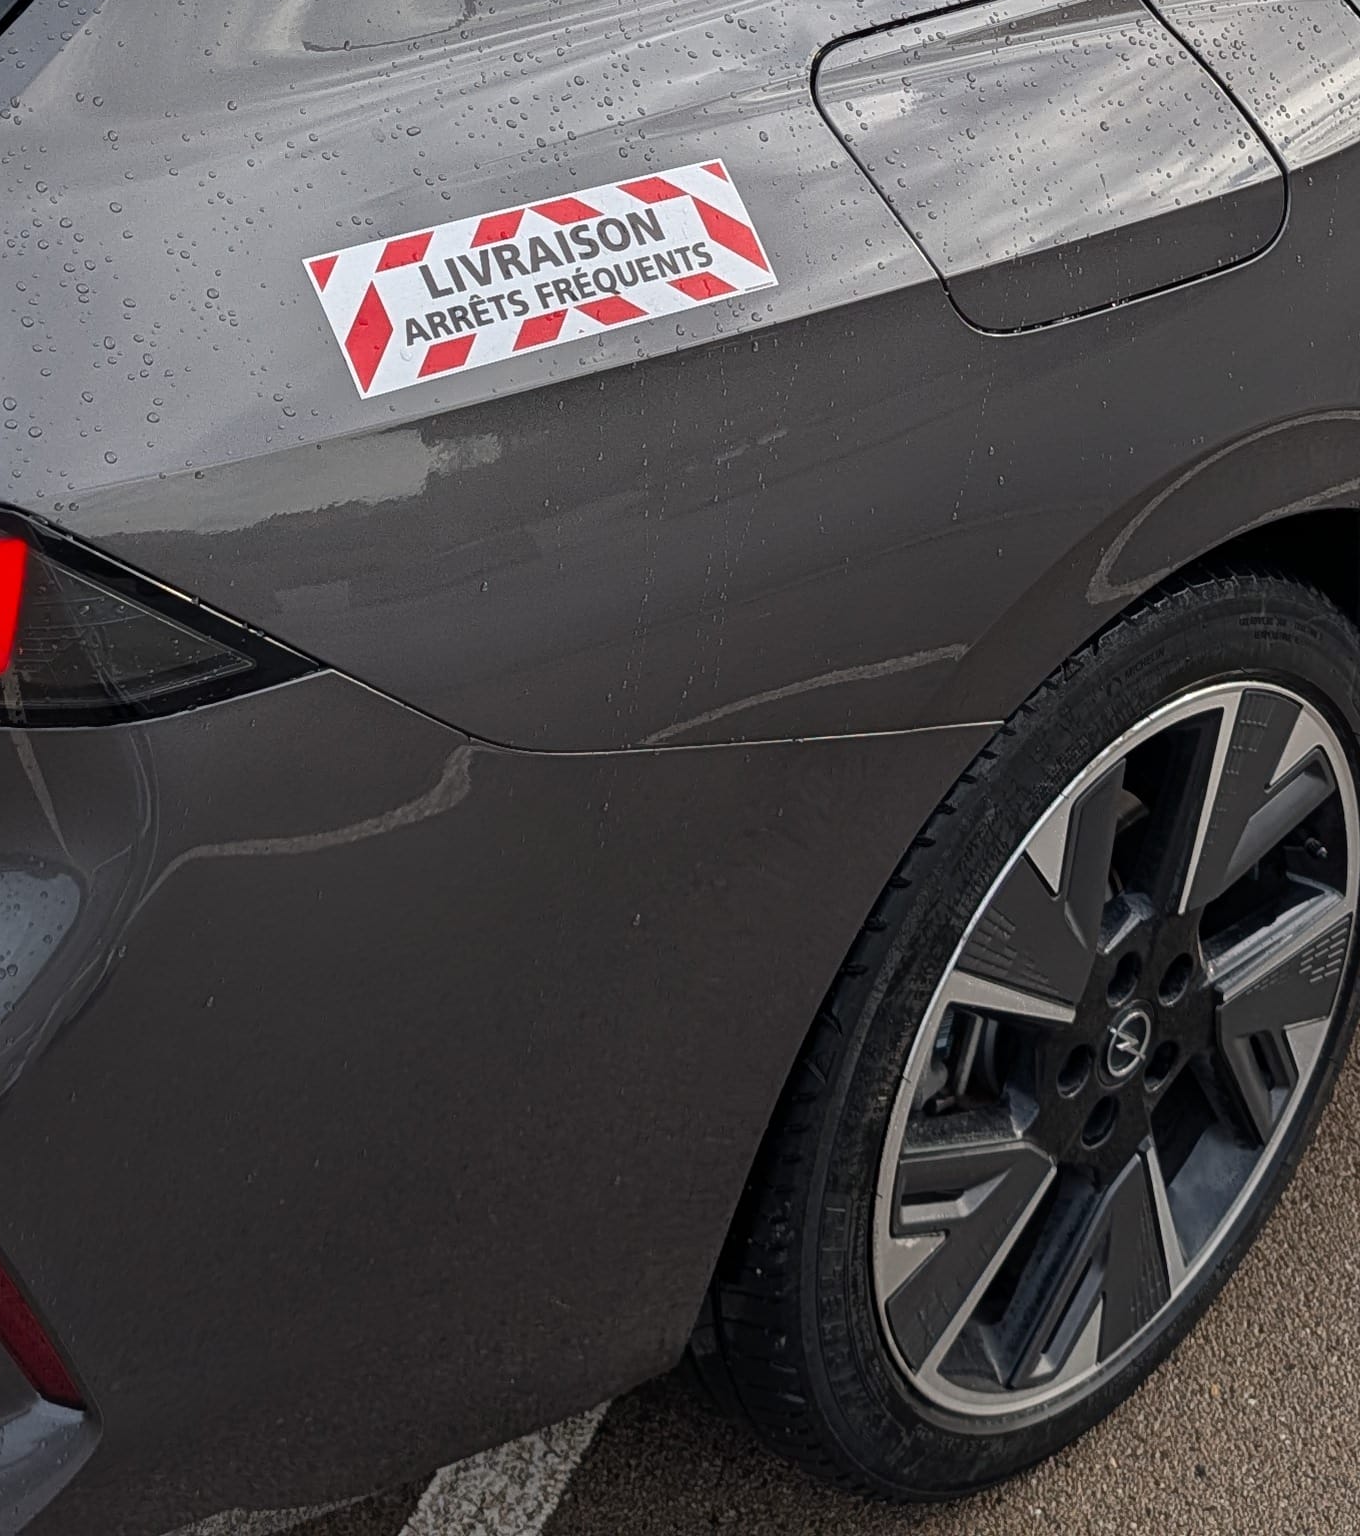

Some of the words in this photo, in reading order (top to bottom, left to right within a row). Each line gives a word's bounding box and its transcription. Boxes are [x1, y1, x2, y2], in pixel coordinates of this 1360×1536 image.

[405, 289, 530, 347] ARRÊTS
[534, 242, 714, 310] FRÉQUENTS
[418, 208, 666, 300] LIVRAISON
